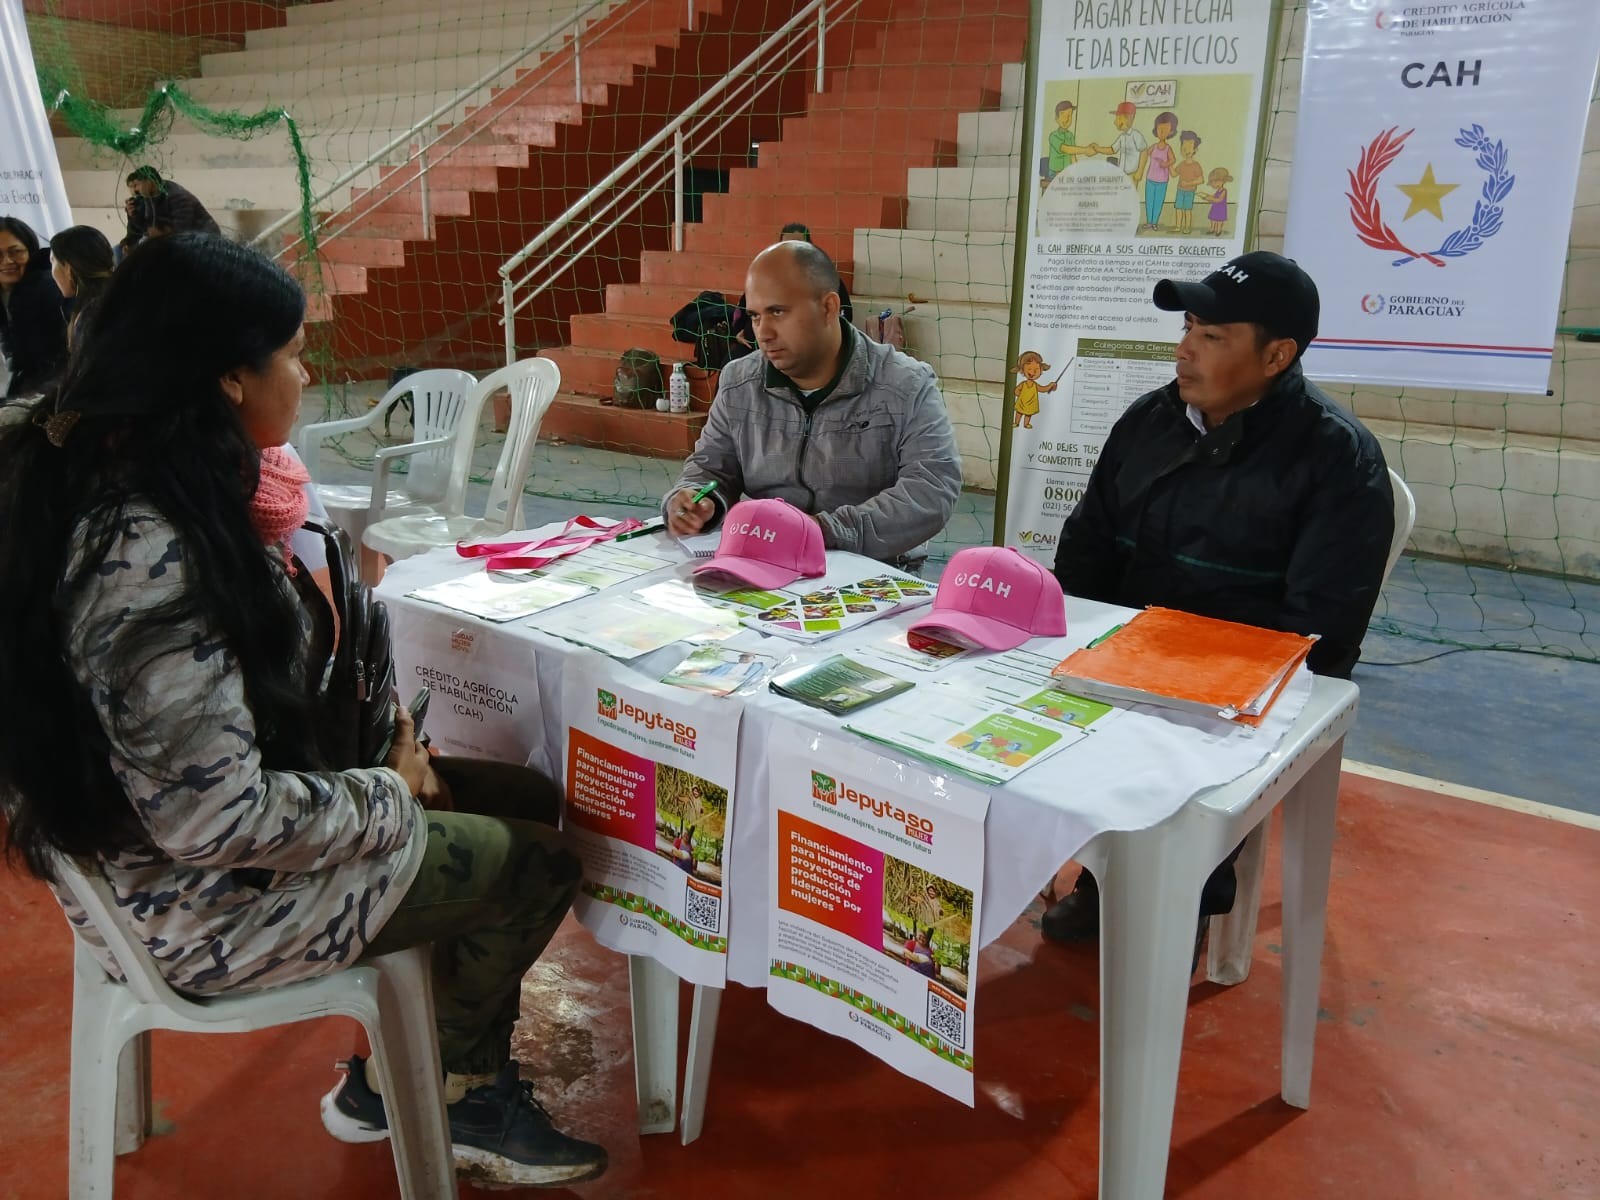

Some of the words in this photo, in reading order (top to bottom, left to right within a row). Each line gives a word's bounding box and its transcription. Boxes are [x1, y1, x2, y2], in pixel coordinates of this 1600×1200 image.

[1074, 0, 1130, 30] PAGAR
[1140, 0, 1165, 26] EN
[1174, 0, 1233, 24] FECHA
[1402, 19, 1418, 29] DE
[1066, 38, 1085, 70] TE
[1091, 38, 1113, 69] DA
[1120, 35, 1240, 68] BENEFICIOS
[1401, 60, 1482, 89] CAH
[1146, 84, 1172, 98] CAH
[1048, 244, 1062, 253] CAH
[1066, 244, 1102, 254] BENEFICIA
[1106, 244, 1112, 254] A
[1116, 245, 1134, 254] SUS
[1138, 244, 1174, 254] CLIENTES
[1178, 246, 1226, 256] EXCELENTES
[1388, 304, 1465, 317] PARAGUAY
[1390, 296, 1449, 304] GOBIERNO
[1028, 454, 1034, 462] Y
[1038, 454, 1082, 467] CONVERTITE
[1086, 458, 1096, 468] EN
[1056, 443, 1078, 452] DEJES
[1083, 445, 1099, 454] TUS
[1044, 486, 1084, 502] 0800
[1063, 504, 1072, 512] 56
[740, 523, 776, 543] CAH
[1032, 532, 1056, 545] CAH
[968, 574, 1012, 599] CAH
[415, 666, 460, 686] CRÉDITO
[463, 680, 519, 704] AGRÍCOLA
[422, 678, 437, 691] DE
[440, 683, 514, 715] HABILITACIÓN
[454, 704, 484, 722] (CAH)
[618, 698, 696, 740] Jepytaso
[576, 758, 595, 774] para
[596, 767, 638, 790] impulsar
[577, 746, 646, 782] Financiamiento
[575, 780, 626, 806] producción
[576, 770, 620, 794] proyectos
[622, 788, 636, 800] de
[574, 790, 618, 813] liderados
[618, 808, 636, 820] por
[574, 802, 612, 820] mujeres
[838, 782, 934, 833] Jepytaso
[877, 828, 912, 846] sembramos
[908, 828, 929, 842] MUJER
[790, 830, 873, 874] Financiamiento
[790, 844, 815, 859] para
[817, 852, 864, 880] impulsar
[790, 855, 845, 884] proyectos
[846, 878, 861, 891] de
[790, 866, 852, 898] producción
[790, 888, 835, 912] mujeres
[791, 876, 842, 904] liderados
[843, 900, 862, 914] por
